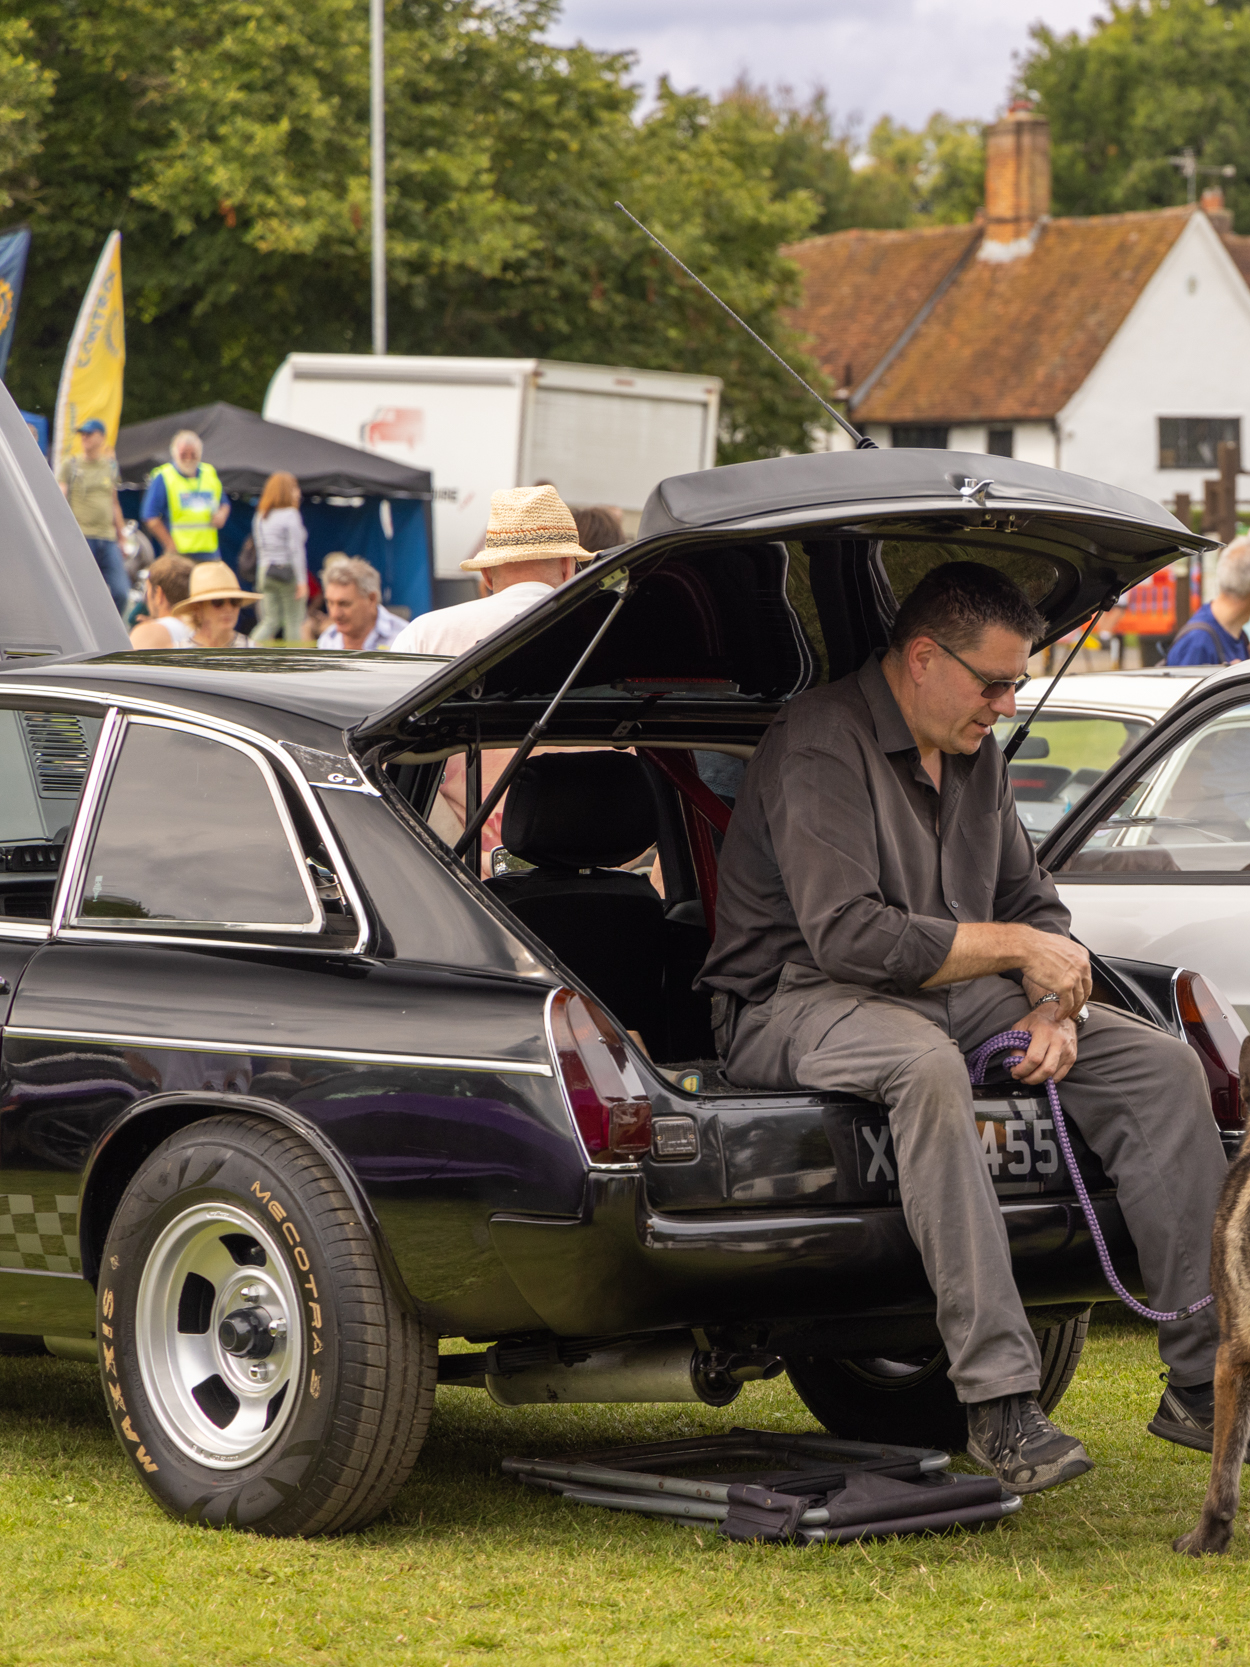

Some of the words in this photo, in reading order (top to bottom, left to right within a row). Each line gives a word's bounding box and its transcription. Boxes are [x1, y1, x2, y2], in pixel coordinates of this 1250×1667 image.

[327, 772, 357, 785] GT
[250, 1180, 325, 1355] MECOTRA
[102, 1287, 160, 1473] MAXXIS
